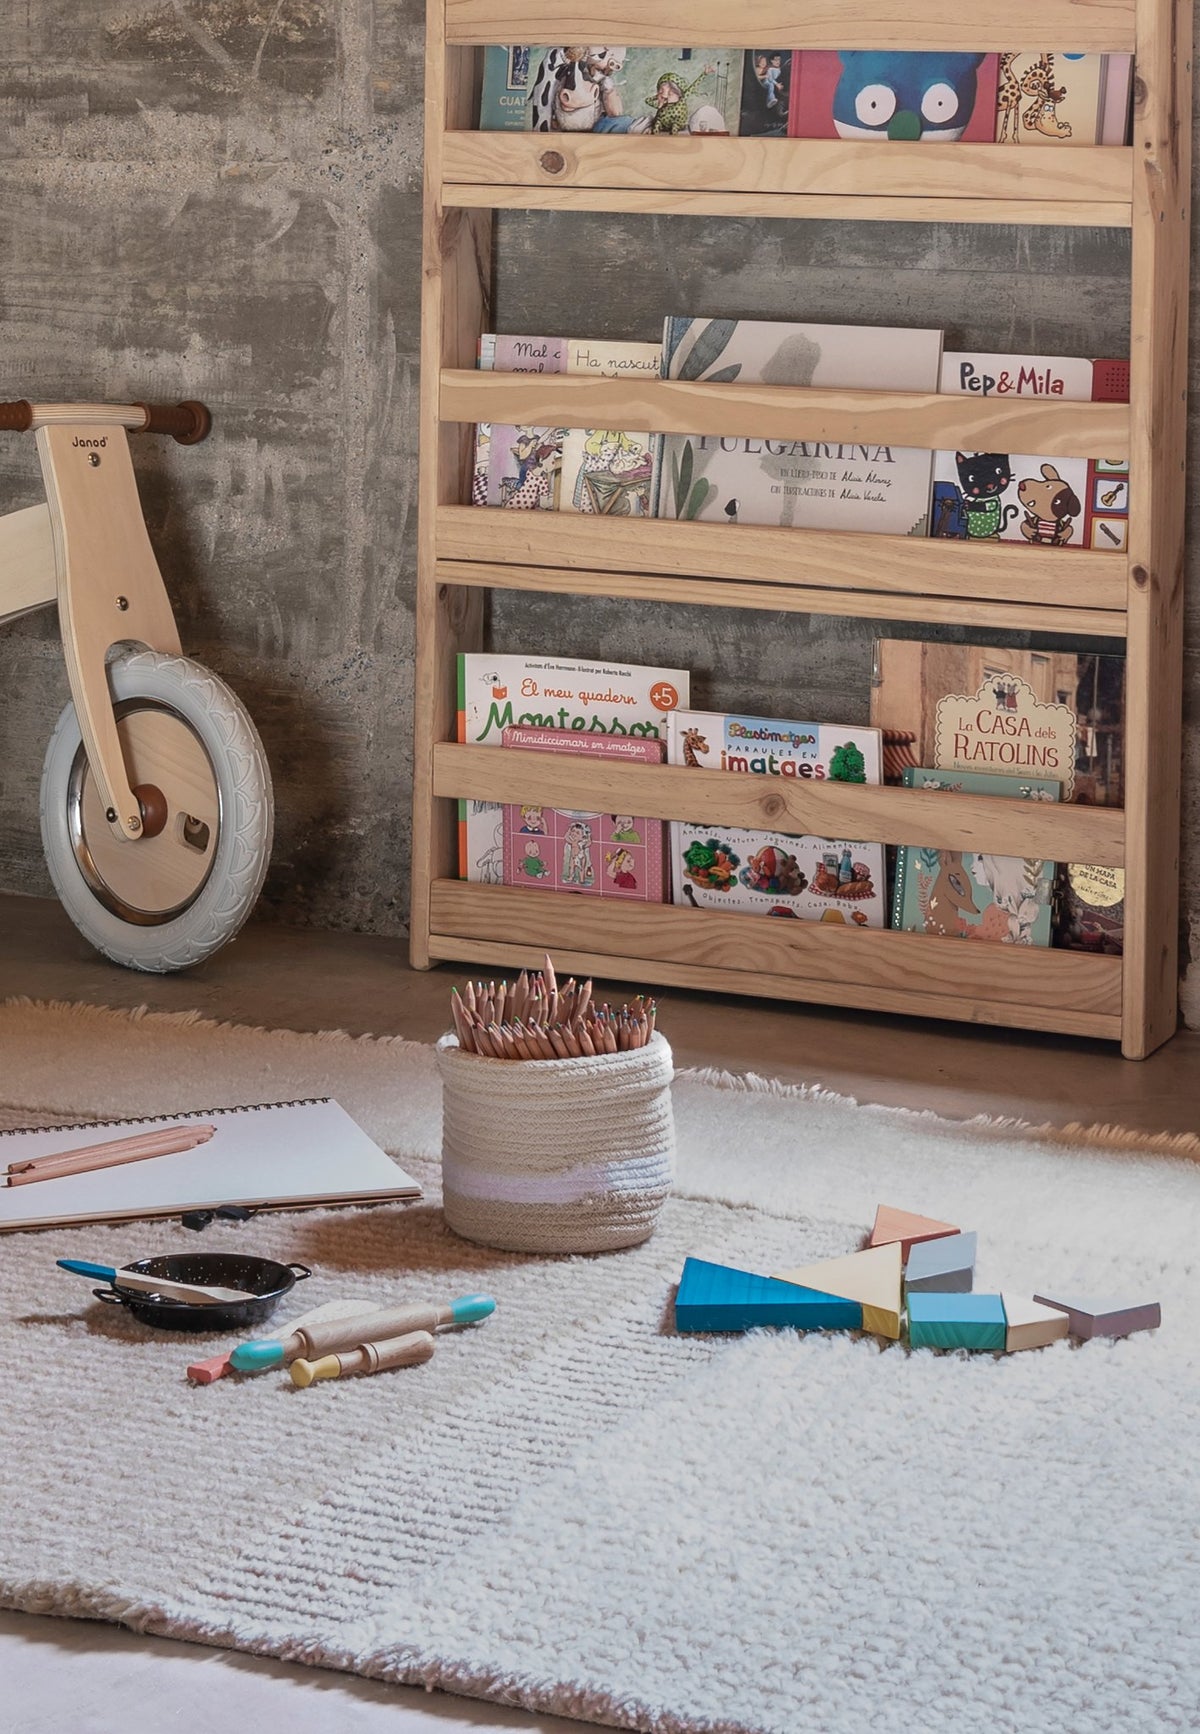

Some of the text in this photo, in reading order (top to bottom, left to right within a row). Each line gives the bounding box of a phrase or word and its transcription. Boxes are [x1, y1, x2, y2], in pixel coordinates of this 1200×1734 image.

[513, 342, 548, 358] Mal
[576, 350, 660, 371] Ha nascut
[960, 362, 1065, 396] Pep&Mila
[521, 678, 637, 706] El meu quadern
[728, 722, 816, 748] Plastimatges
[959, 709, 1057, 740] La CASA dels
[512, 731, 646, 755] Minidiccionari en imatges
[727, 743, 793, 757] PARAULES
[953, 733, 1060, 769] RATOLINS
